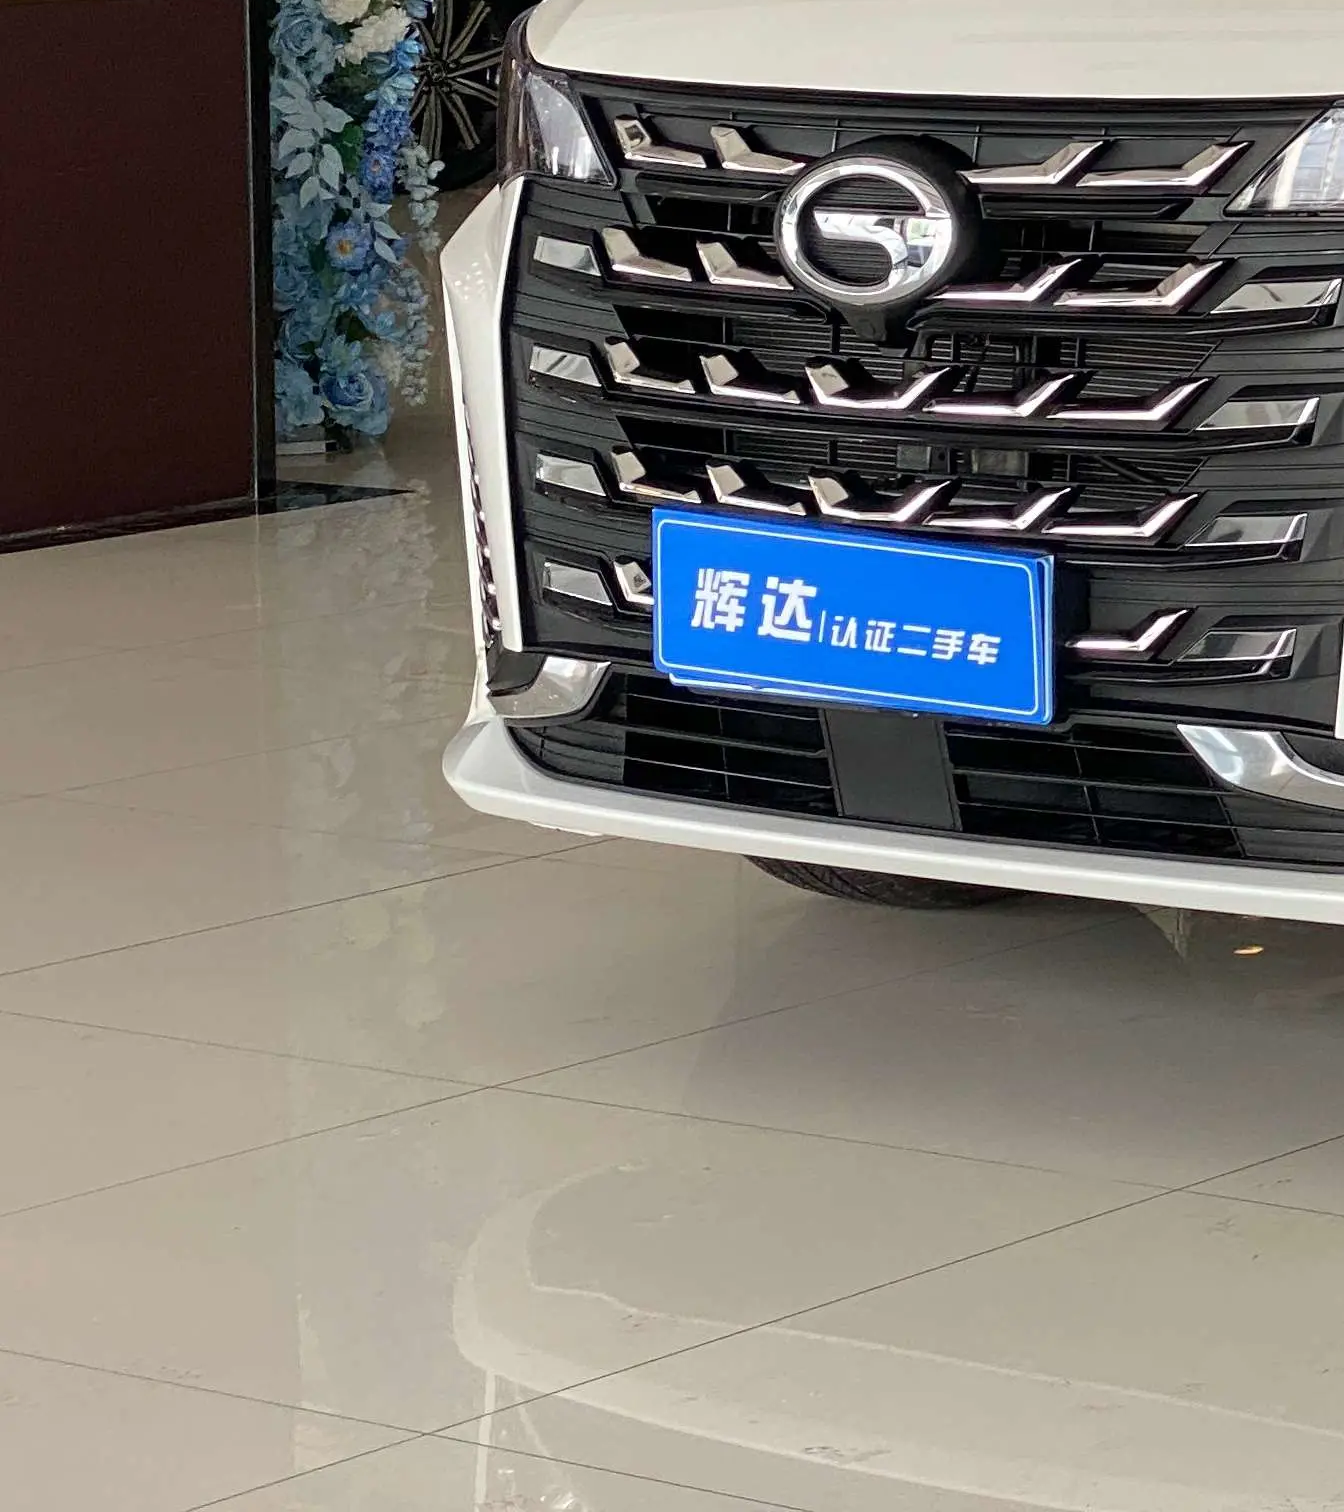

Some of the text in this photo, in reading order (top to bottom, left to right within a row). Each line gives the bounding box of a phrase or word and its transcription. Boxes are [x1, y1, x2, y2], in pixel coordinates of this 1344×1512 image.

[690, 568, 1002, 666] 辉达 认证二手车
